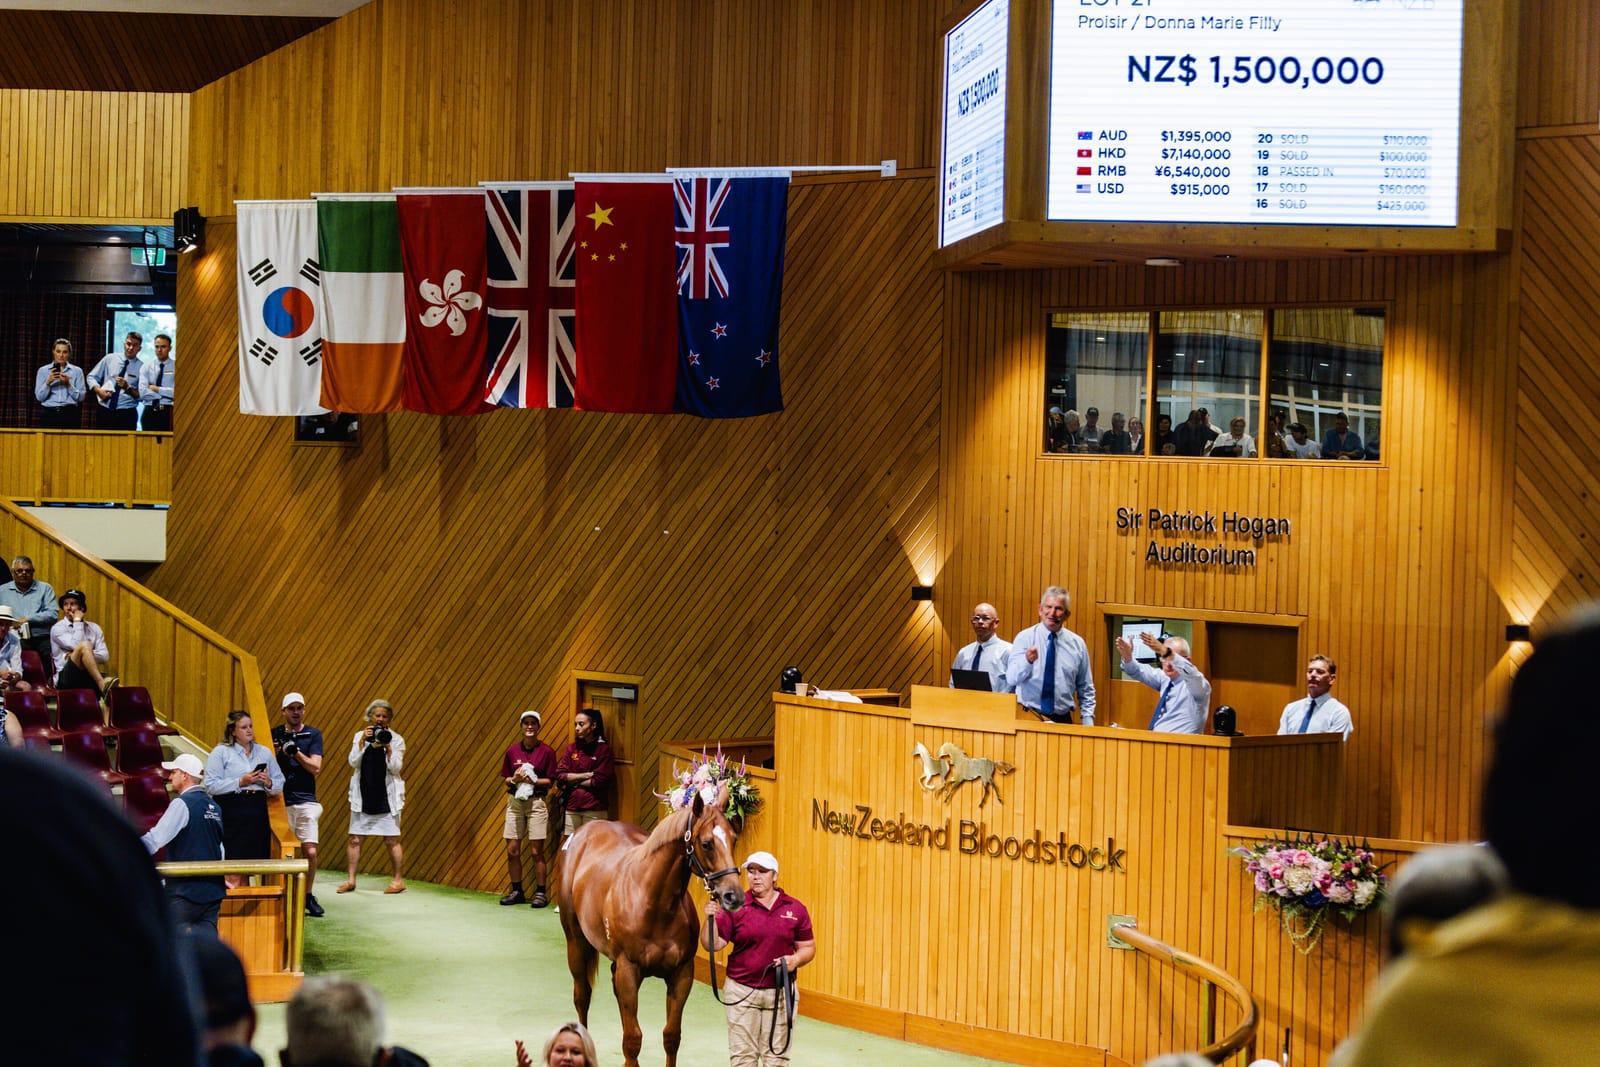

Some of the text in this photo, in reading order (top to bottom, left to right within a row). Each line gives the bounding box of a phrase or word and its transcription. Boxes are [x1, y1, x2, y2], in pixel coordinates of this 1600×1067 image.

[1078, 14, 1282, 32] Proisir / Donna Marie Filly
[1127, 54, 1384, 88] NZ$ 1,500,000
[1098, 130, 1231, 143] AUD $1,395,000
[1257, 133, 1273, 144] 20
[1280, 134, 1309, 144] SOLD
[1098, 148, 1231, 161] HKD $7,140,000
[1257, 150, 1270, 159] 19
[1280, 150, 1309, 160] SOLD
[1098, 165, 1231, 179] RMB ¥6,540,000
[1257, 166, 1269, 176] 18
[1279, 167, 1320, 177] PASSED
[1323, 167, 1334, 177] IN
[1097, 183, 1230, 196] USD $915,000
[1256, 182, 1268, 192] 17
[1279, 183, 1307, 193] SOLD
[1256, 199, 1268, 209] 16
[1279, 199, 1307, 209] SOLD
[1116, 507, 1291, 540] Sir Patrick Hogan
[1145, 540, 1257, 567] Auditorium
[959, 819, 1126, 874] Bloodstock
